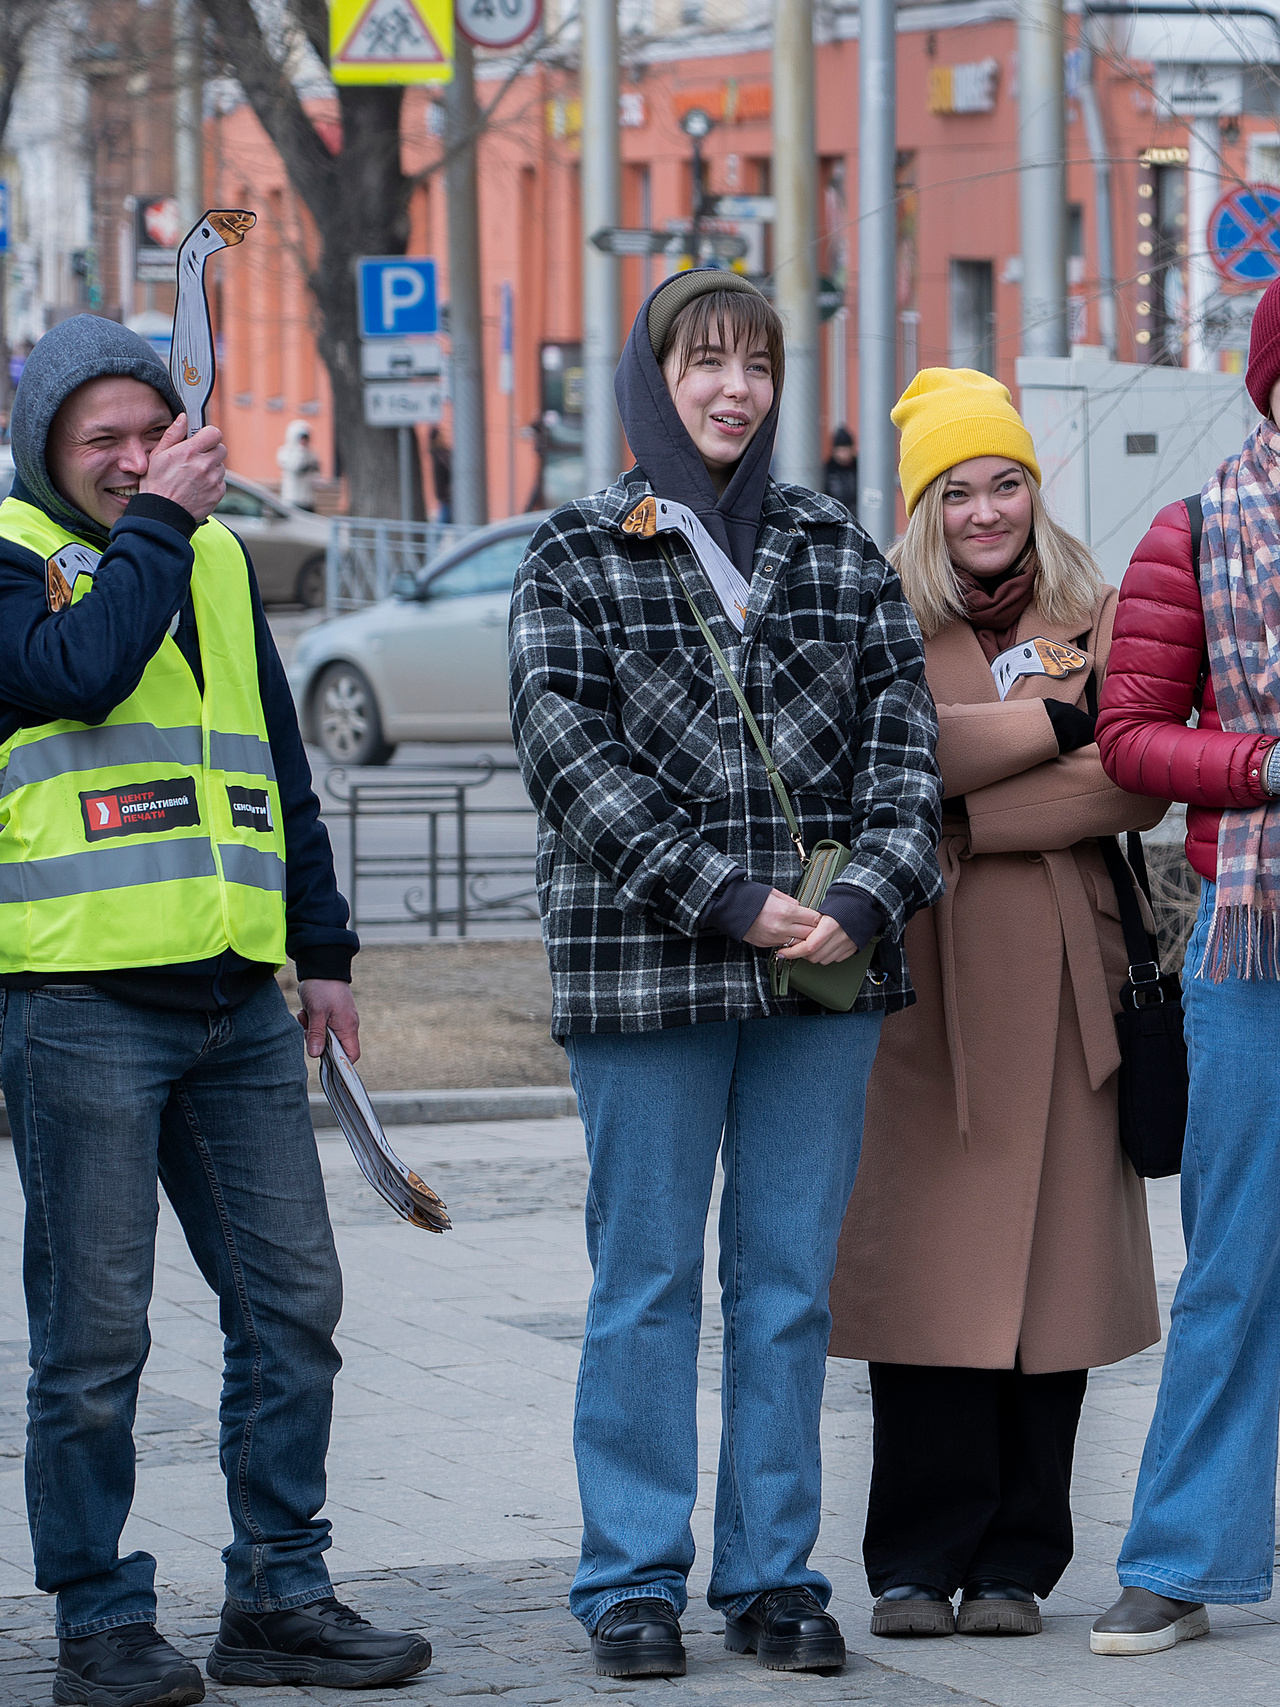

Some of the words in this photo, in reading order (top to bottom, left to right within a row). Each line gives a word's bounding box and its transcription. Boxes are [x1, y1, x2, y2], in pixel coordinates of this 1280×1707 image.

[471, 0, 522, 19] 40
[381, 266, 426, 330] P
[119, 791, 154, 805] ЦЕНТР
[121, 795, 189, 814] ОПЕРАТИВНОЙ
[123, 810, 166, 824] ПЕЧАТИ
